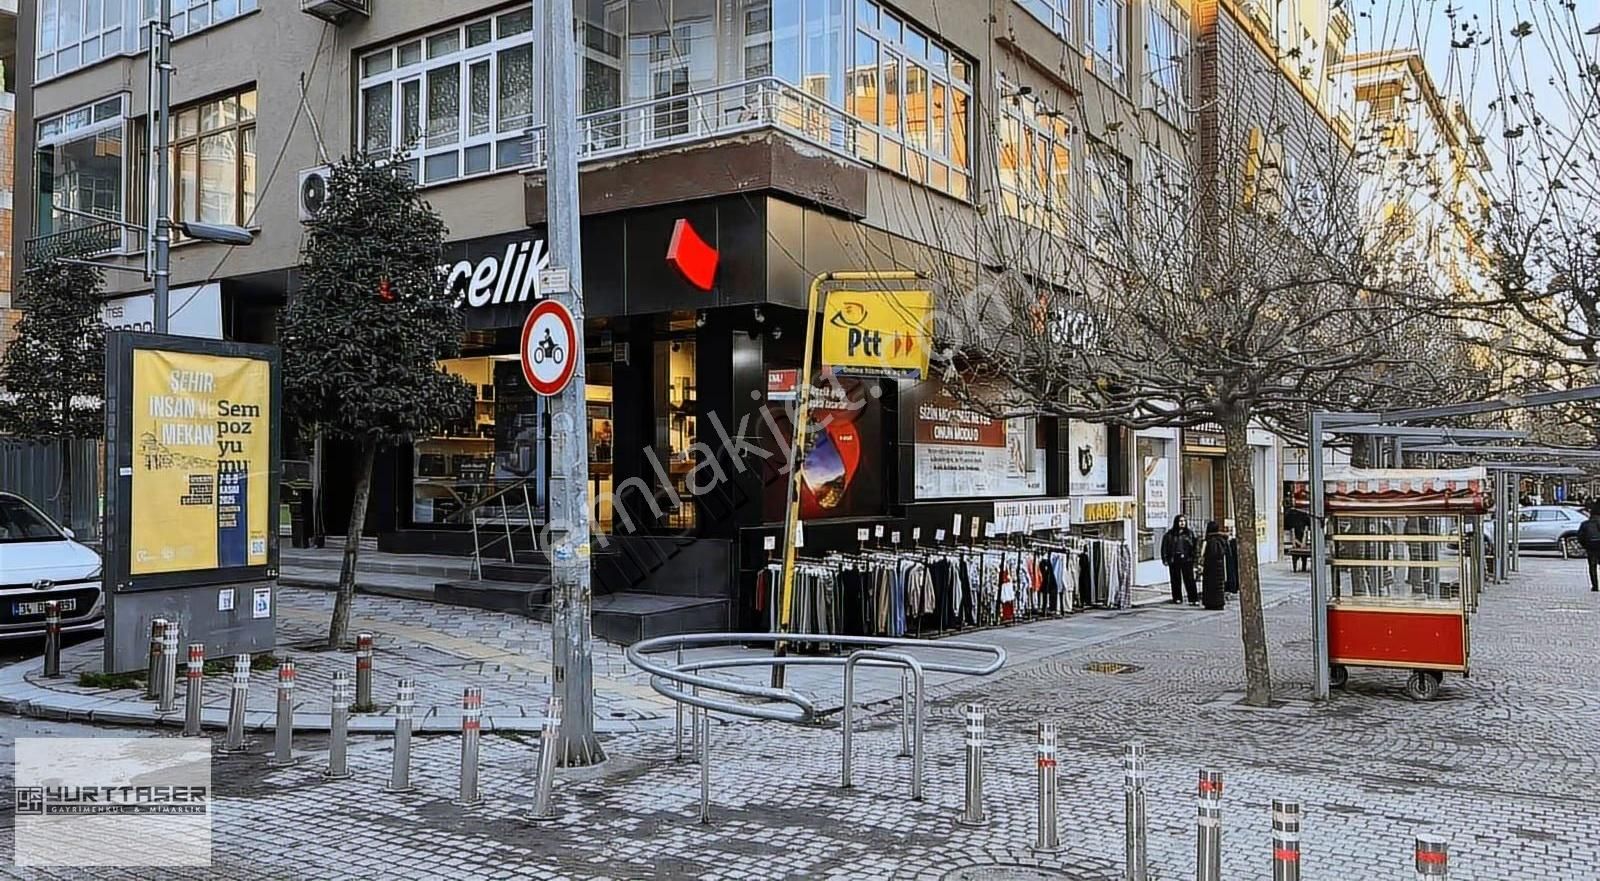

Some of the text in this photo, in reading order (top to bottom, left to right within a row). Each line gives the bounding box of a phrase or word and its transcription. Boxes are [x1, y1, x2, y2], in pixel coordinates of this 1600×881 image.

[848, 327, 882, 357] Ptt
[217, 399, 260, 418] Sem
[163, 424, 213, 444] MEKAN
[216, 420, 252, 438] poz
[217, 440, 242, 457] yu
